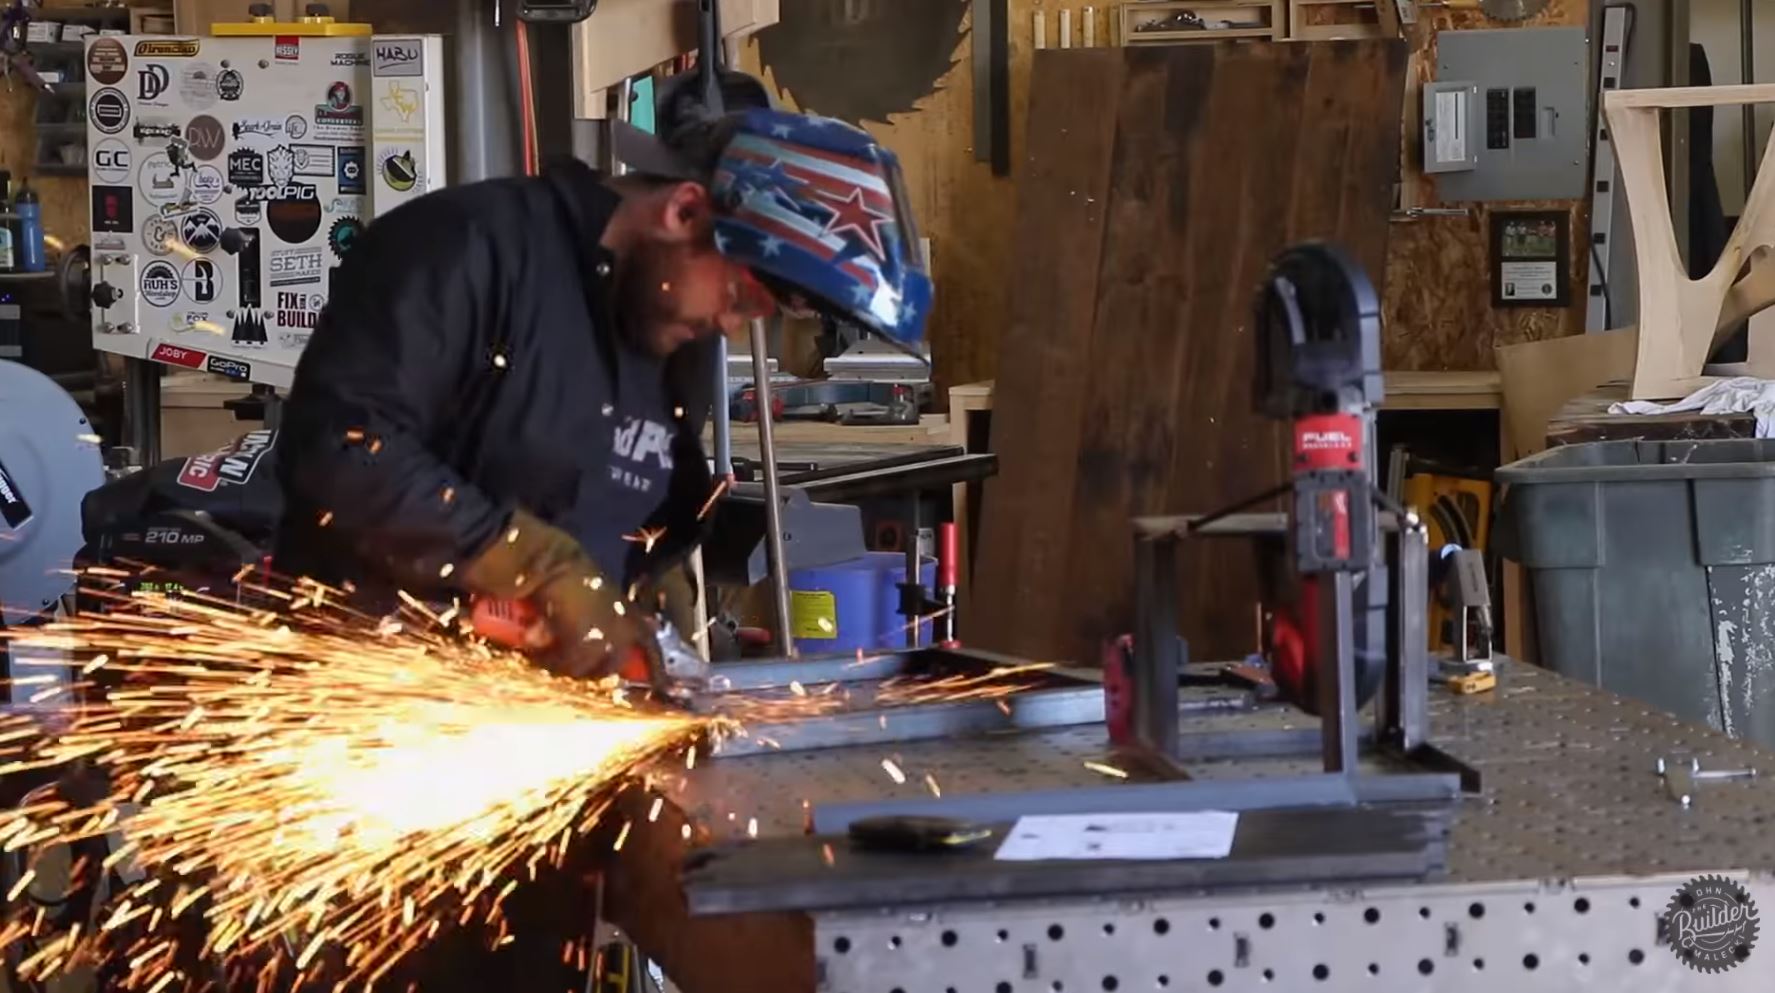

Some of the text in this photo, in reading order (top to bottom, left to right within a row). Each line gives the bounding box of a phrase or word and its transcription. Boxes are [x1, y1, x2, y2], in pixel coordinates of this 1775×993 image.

[230, 158, 261, 171] MEC
[270, 253, 322, 272] SETH
[278, 291, 298, 310] FIX
[277, 310, 317, 329] BUILD
[159, 347, 188, 359] JOBY
[210, 358, 248, 372] GoPro
[1303, 432, 1346, 442] FUEL
[145, 531, 205, 544] 210 MP
